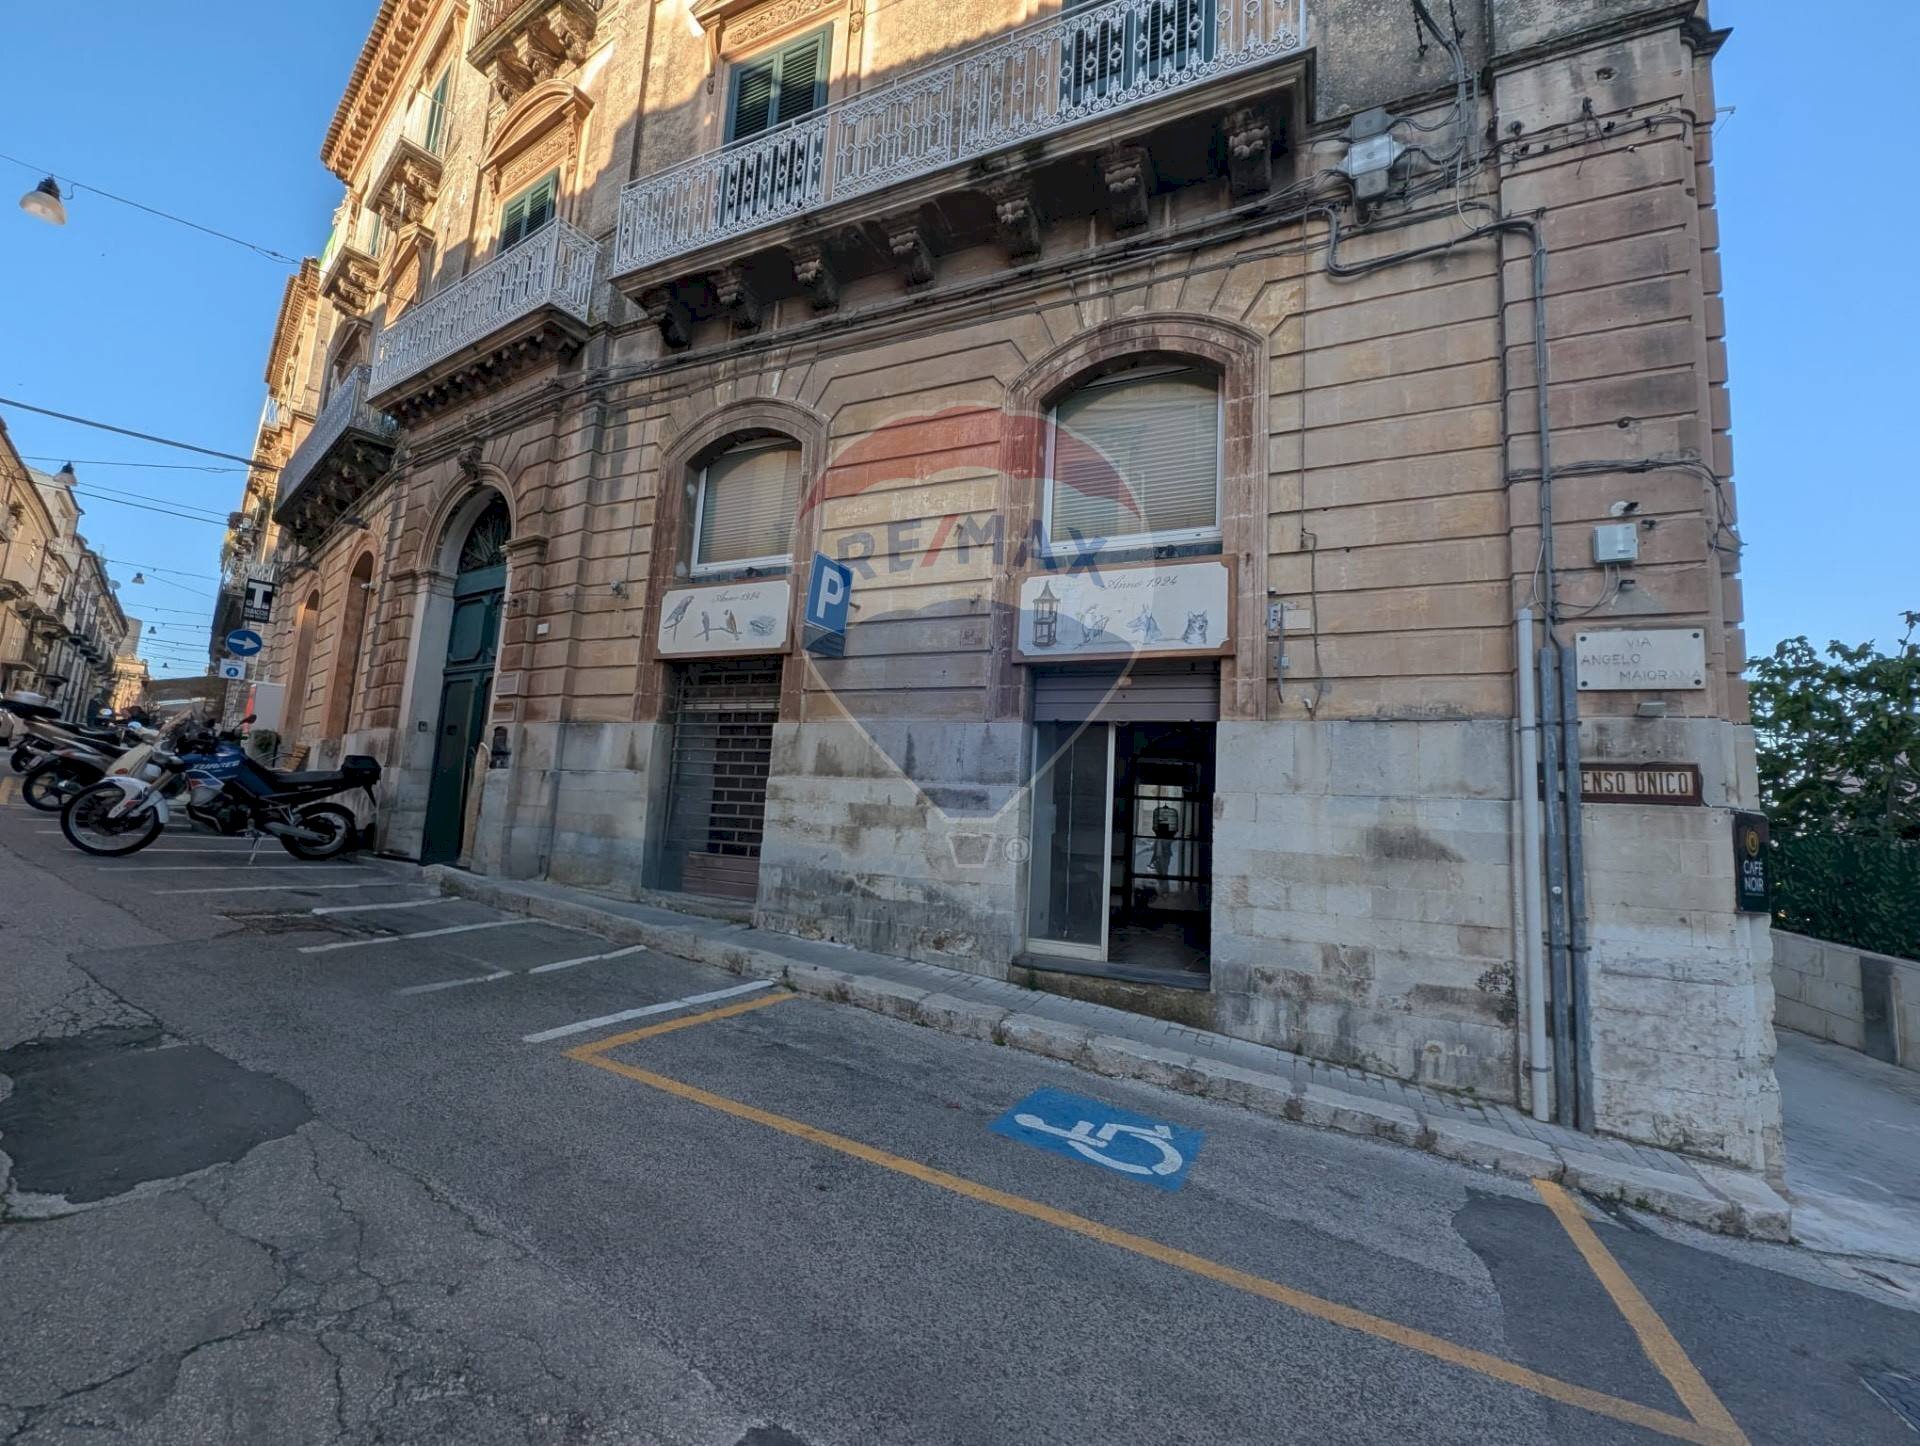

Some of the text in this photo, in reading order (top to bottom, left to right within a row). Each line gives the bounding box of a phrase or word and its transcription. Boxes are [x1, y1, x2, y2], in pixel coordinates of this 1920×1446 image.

[248, 582, 273, 609] T
[816, 566, 844, 619] P
[1625, 637, 1653, 649] VIA
[1580, 653, 1641, 666] ANGELO
[1581, 771, 1689, 794] ENSO UNICO
[1744, 877, 1765, 892] NOIR
